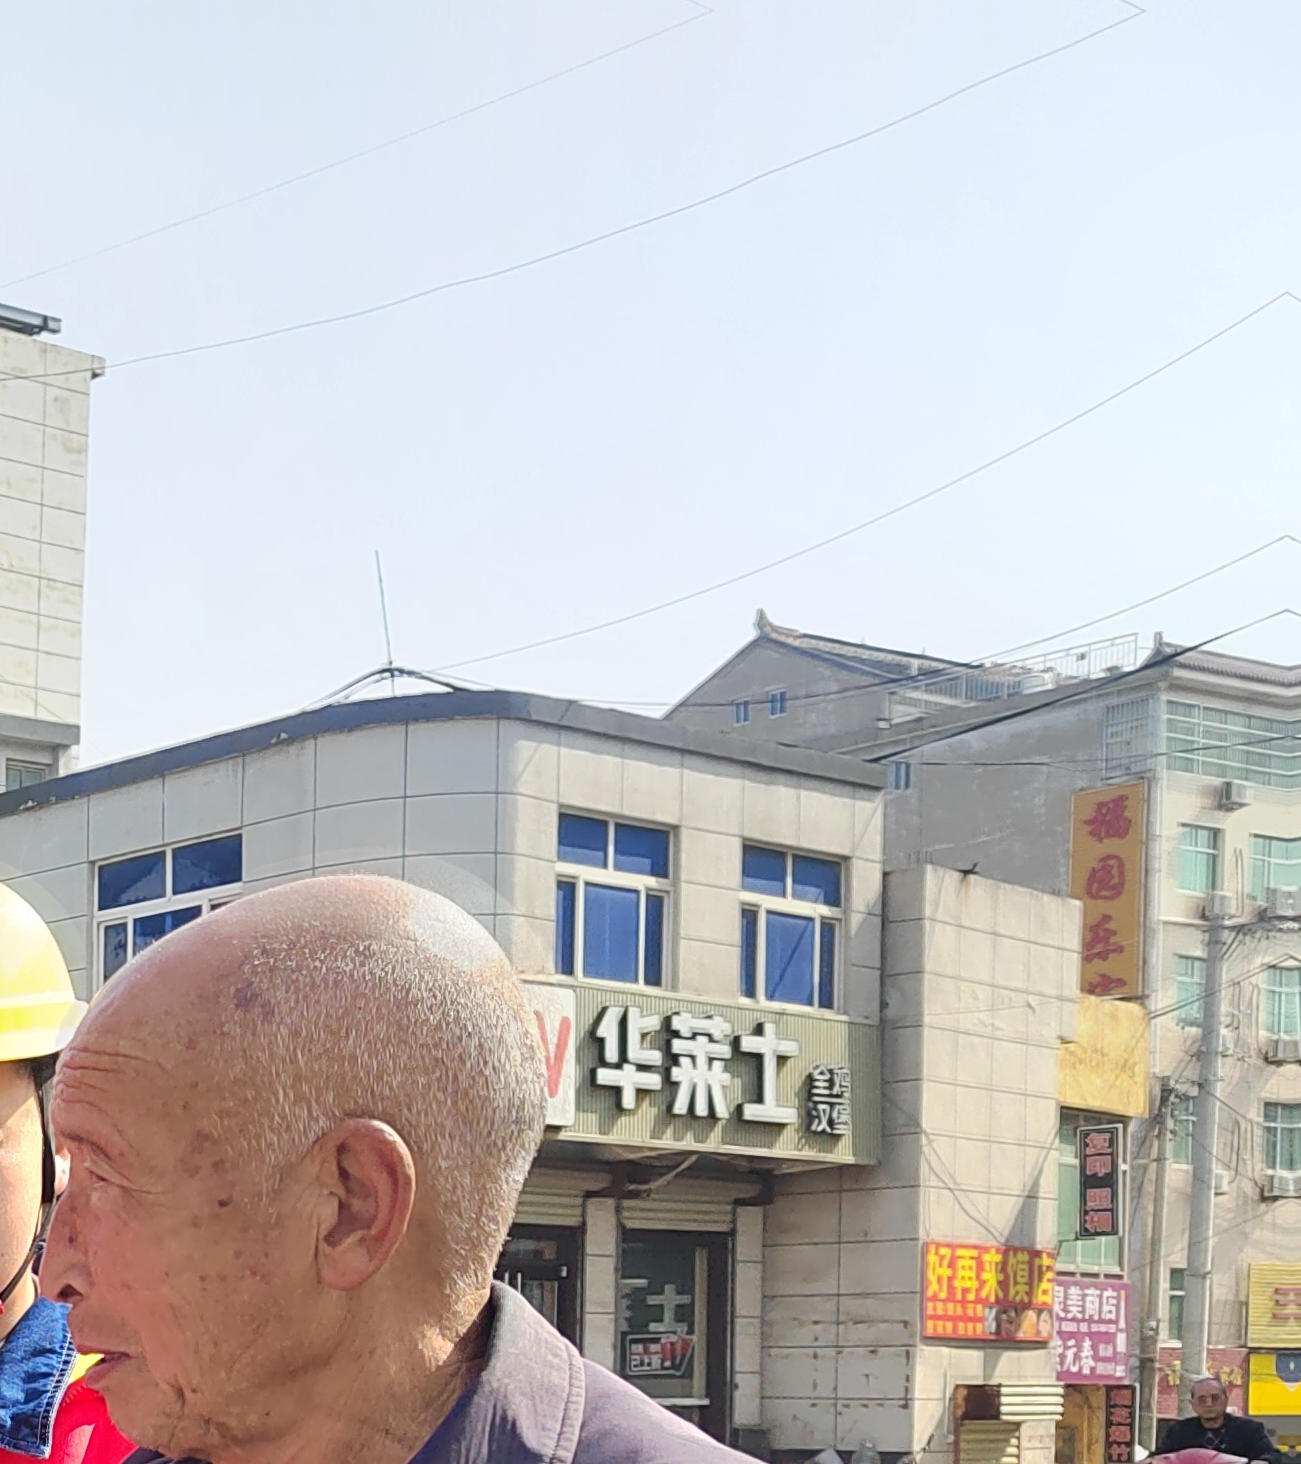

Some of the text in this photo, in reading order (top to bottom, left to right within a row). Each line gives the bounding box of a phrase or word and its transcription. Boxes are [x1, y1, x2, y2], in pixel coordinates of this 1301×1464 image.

[595, 1005, 799, 1124] 华莱士
[810, 1064, 851, 1098] 全鸡
[807, 1101, 853, 1135] 汉堡
[926, 1243, 1054, 1305] 好再来馍店
